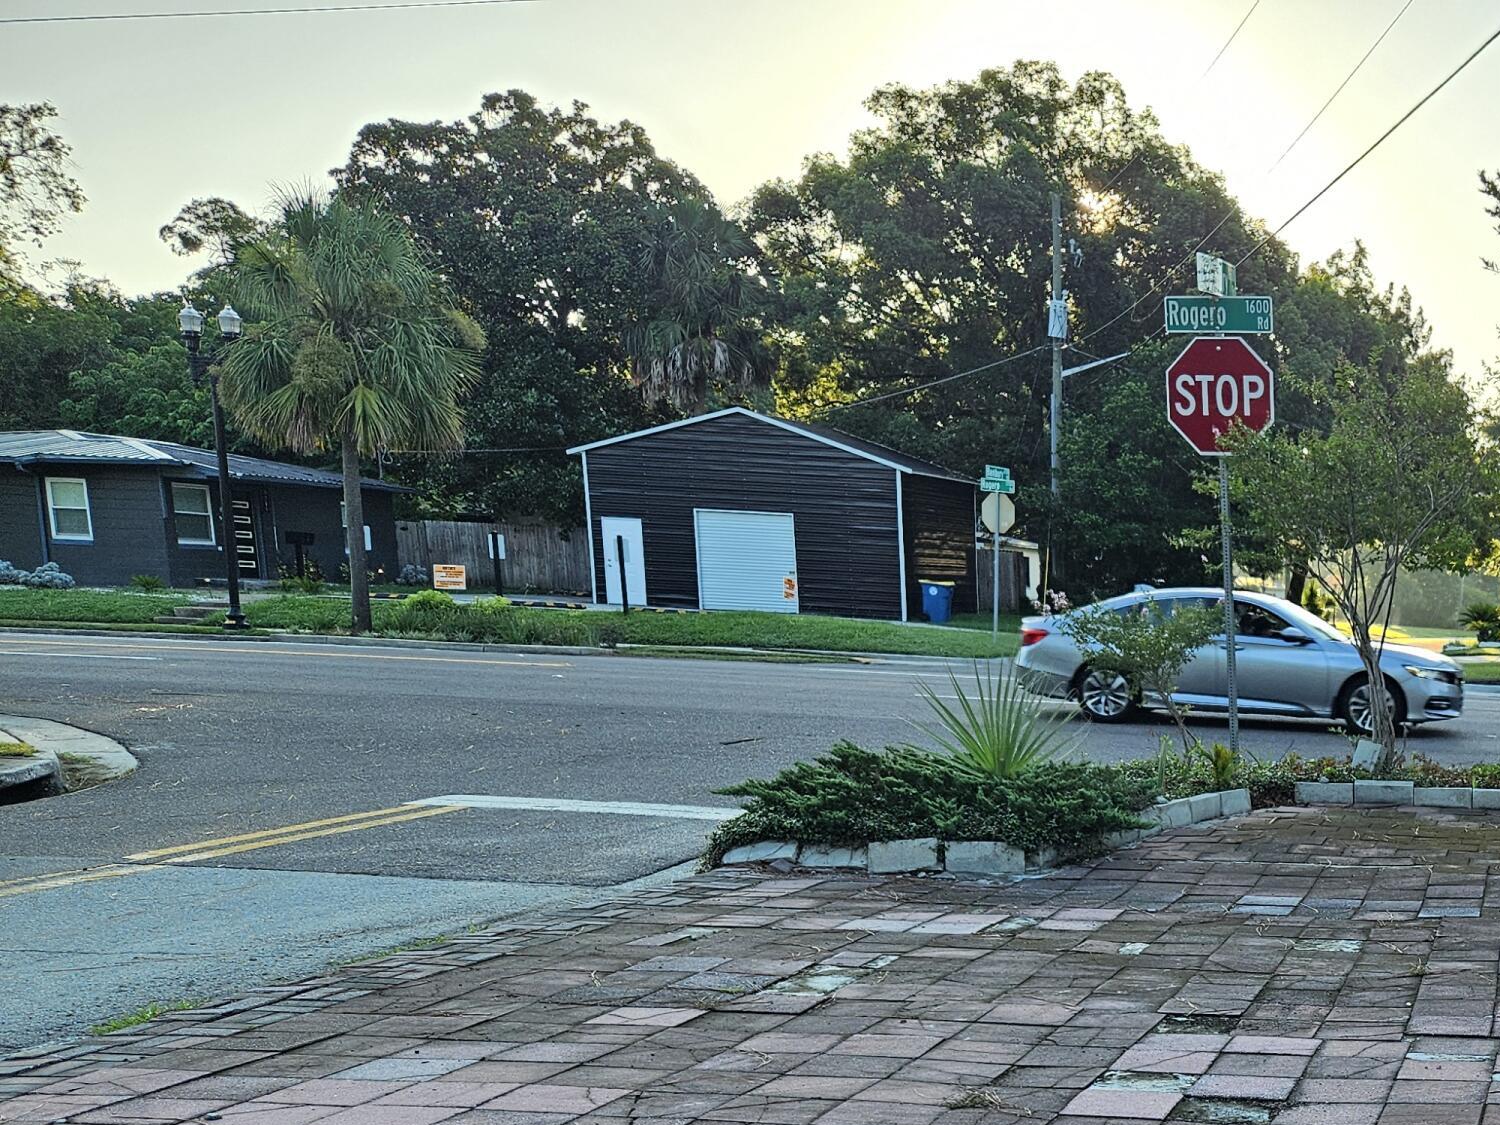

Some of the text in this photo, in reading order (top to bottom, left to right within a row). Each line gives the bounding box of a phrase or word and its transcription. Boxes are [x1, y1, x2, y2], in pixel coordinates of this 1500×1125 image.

[1169, 300, 1226, 330] Rogero
[1246, 299, 1269, 314] 1600
[1258, 316, 1269, 330] Rd
[1175, 374, 1265, 417] STOP
